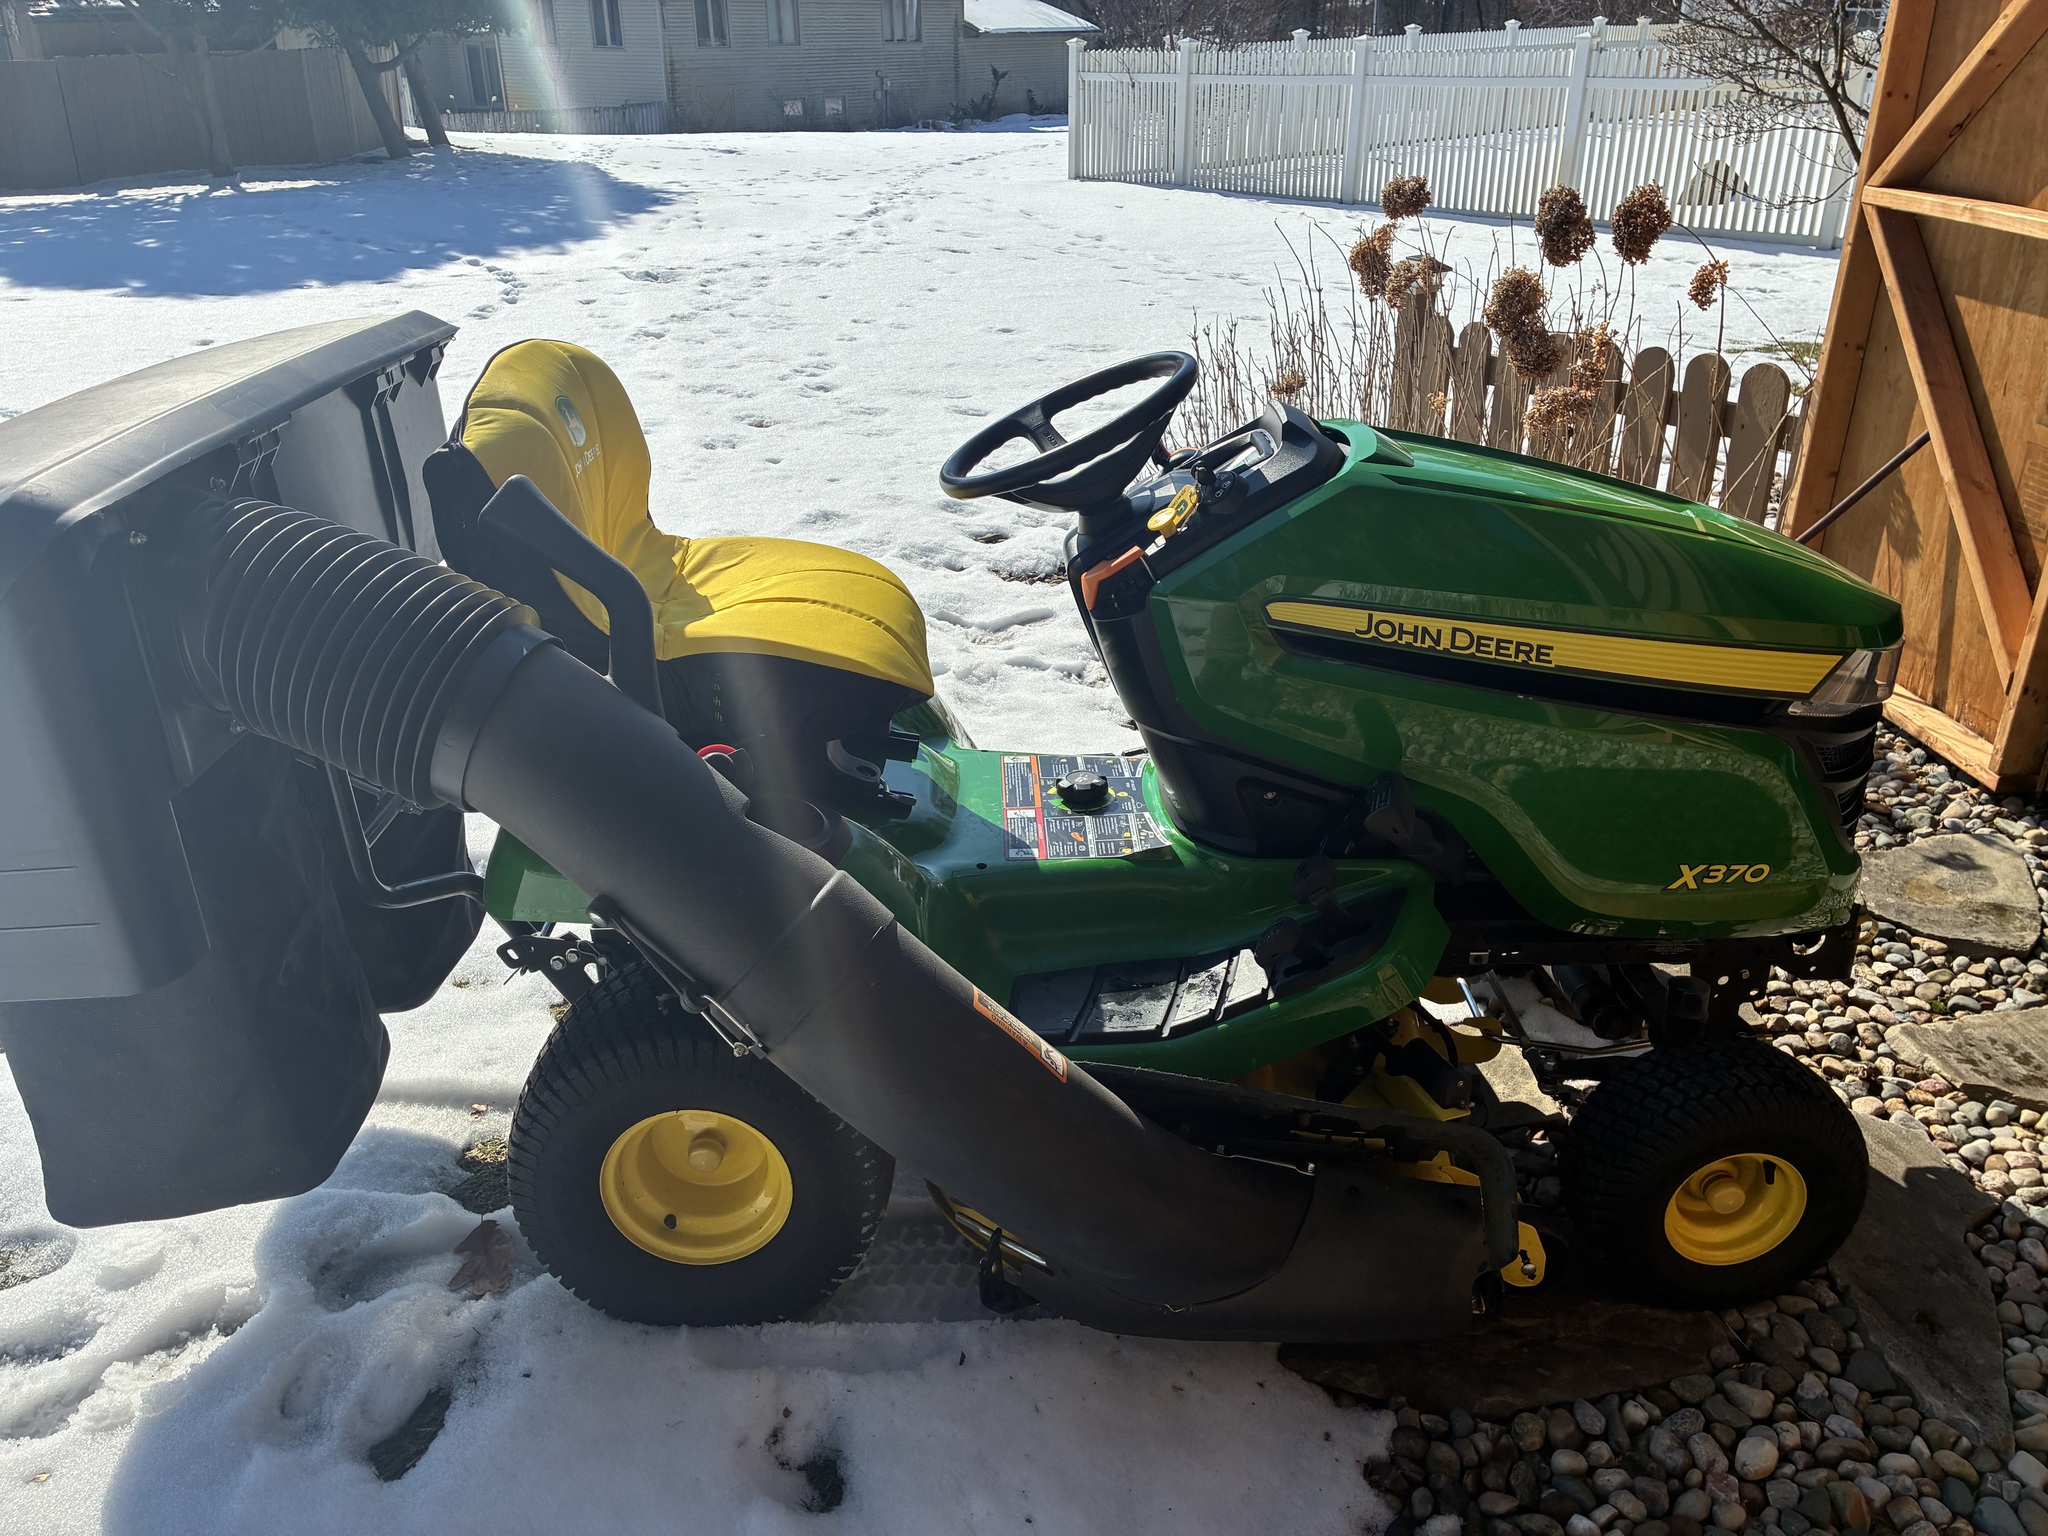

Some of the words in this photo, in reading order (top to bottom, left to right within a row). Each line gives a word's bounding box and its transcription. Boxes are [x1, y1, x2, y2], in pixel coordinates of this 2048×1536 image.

[1355, 613, 1442, 648] JOHN
[1450, 627, 1554, 665] DEERE
[1667, 863, 1771, 890] X370
